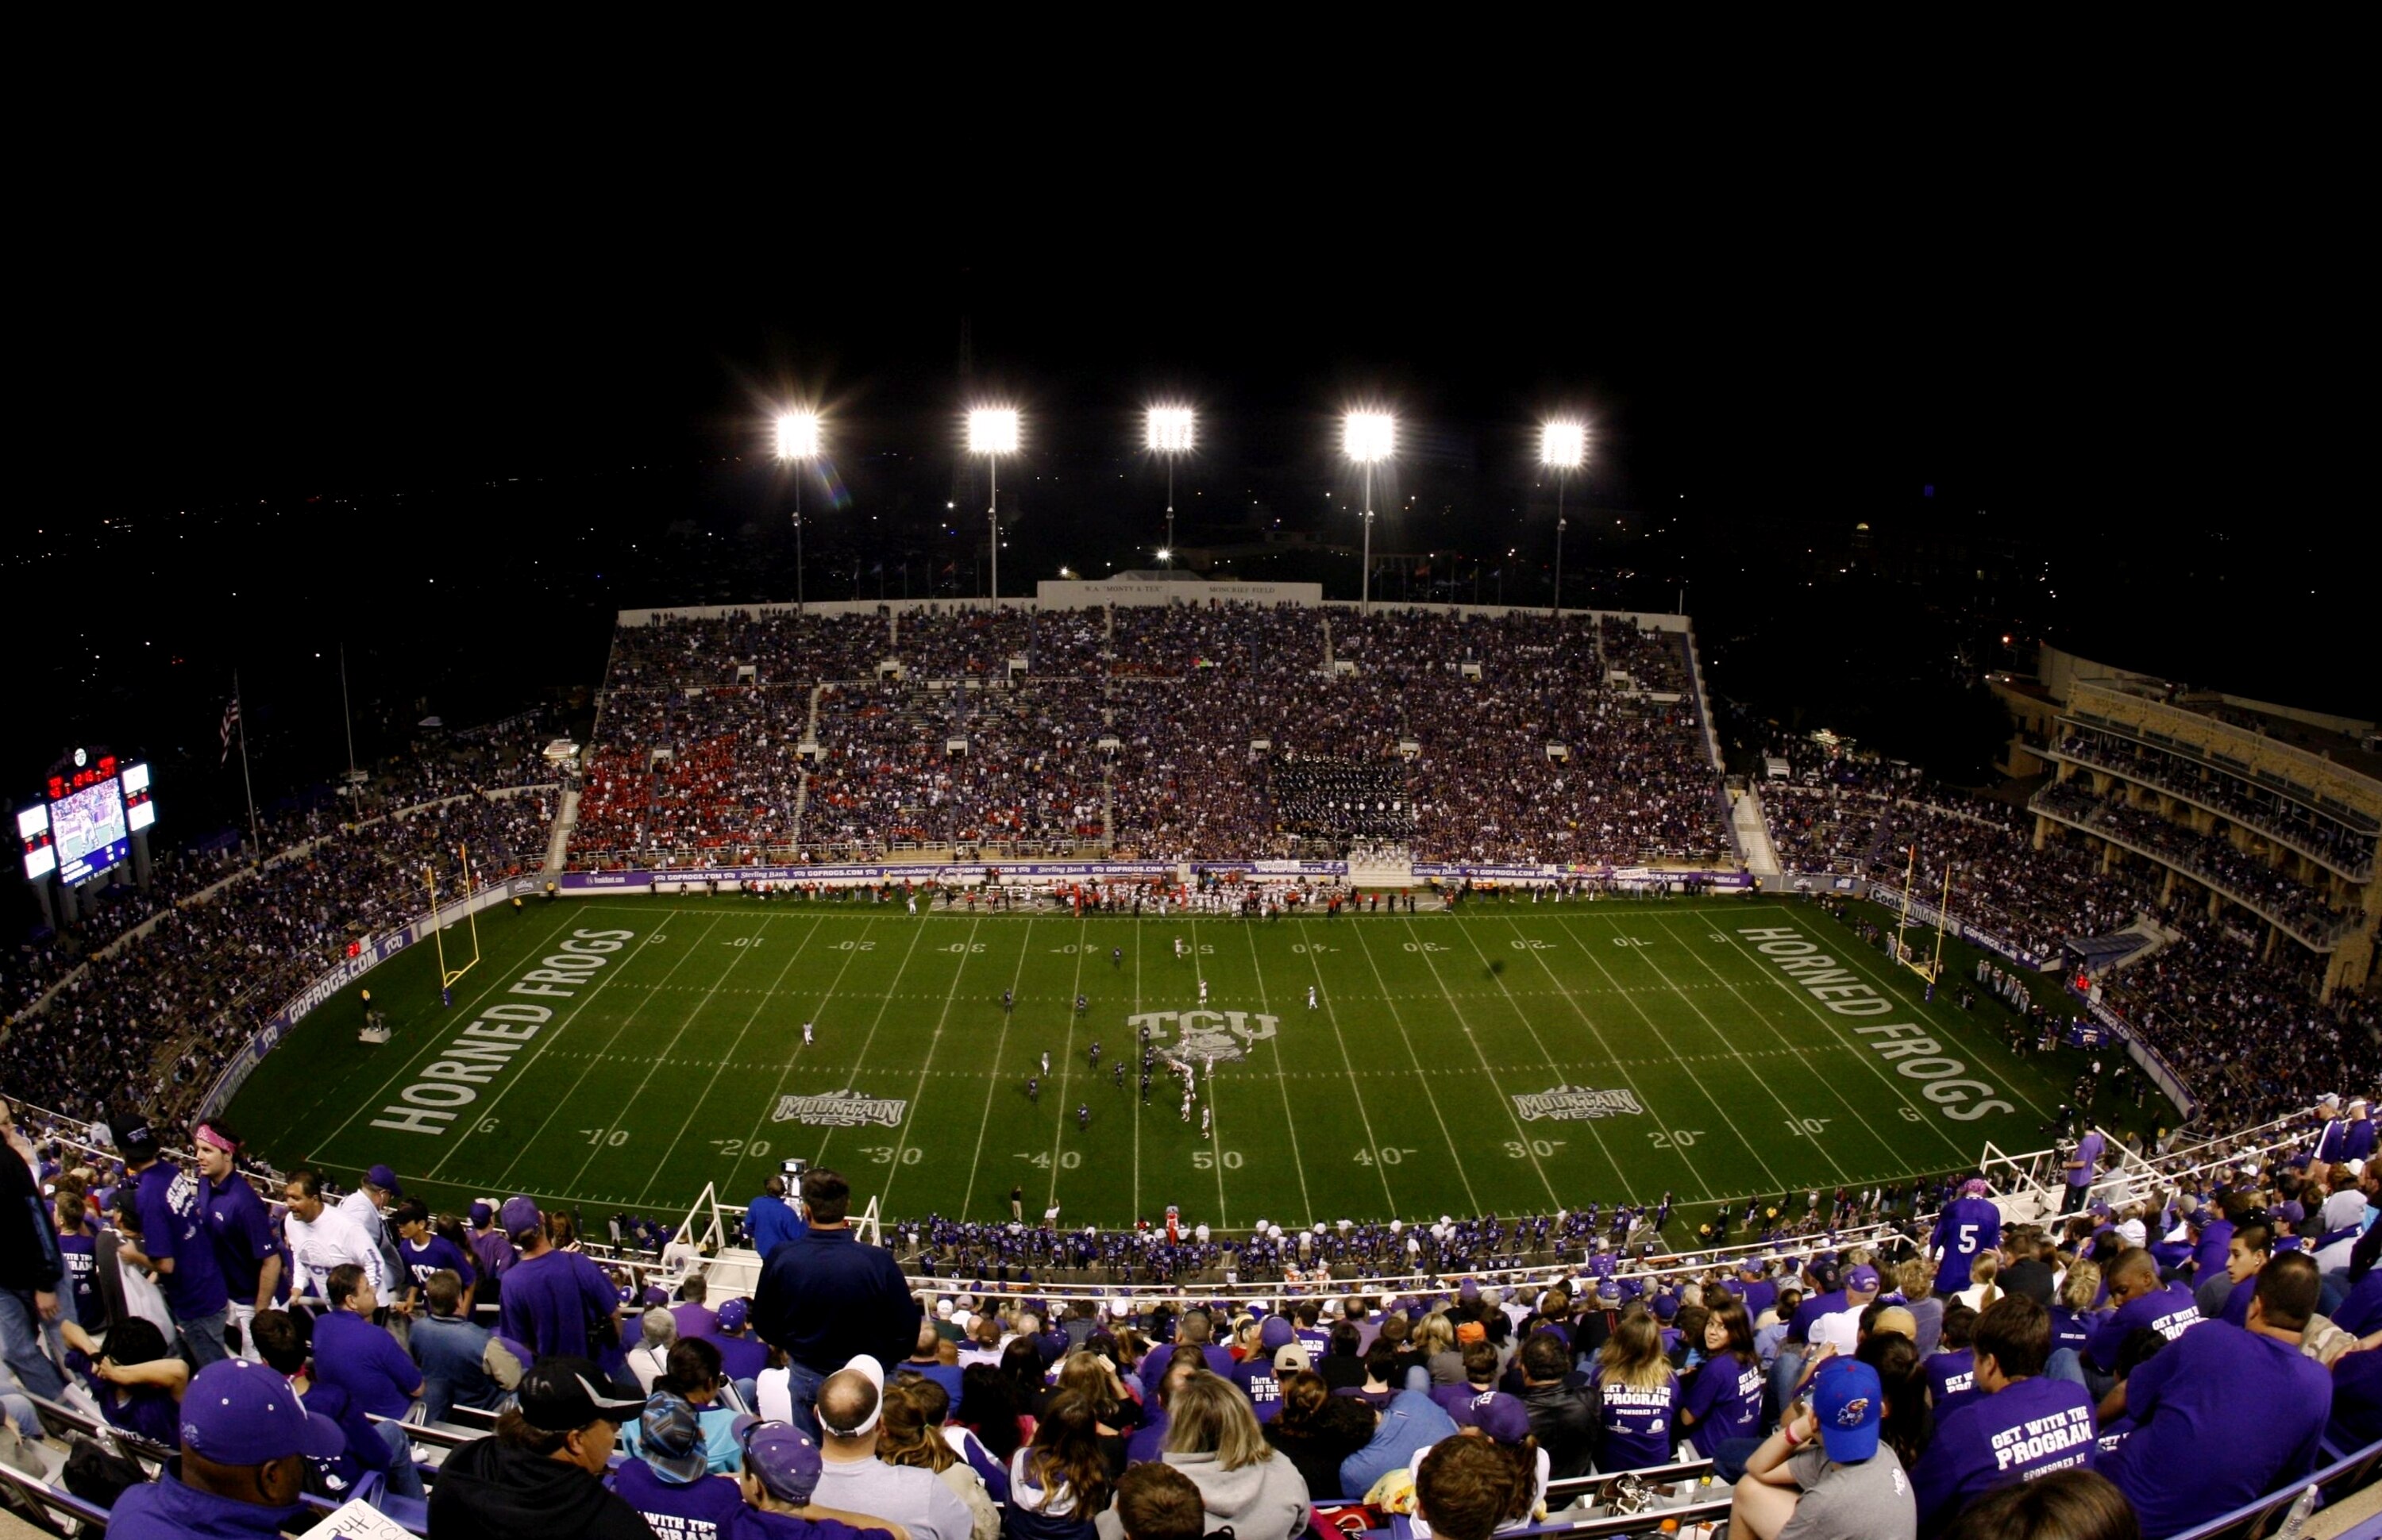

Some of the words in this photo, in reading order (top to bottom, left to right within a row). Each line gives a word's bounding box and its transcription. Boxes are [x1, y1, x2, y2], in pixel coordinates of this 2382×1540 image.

[347, 941, 360, 957] 21
[384, 934, 403, 955] TCU
[734, 937, 764, 949] 10
[841, 940, 877, 952] 20
[950, 942, 986, 953] 30
[1062, 944, 1100, 954] 40
[1181, 944, 1215, 955] 50
[1291, 943, 1327, 954] 40
[1403, 941, 1437, 953] 30
[1510, 939, 1544, 951] 20
[1612, 937, 1641, 948] 10
[288, 947, 379, 1024] GOFROGS.COM
[369, 1003, 553, 1135] HORNED
[507, 929, 634, 997] FROGS
[1127, 1010, 1280, 1041] TCU
[1736, 926, 1894, 1016] HORNED
[1853, 1022, 2016, 1121] FROGS
[262, 1025, 278, 1049] TCU
[773, 1095, 906, 1123] MOUNTAIN
[1512, 1088, 1644, 1118] MOUNTAIN
[800, 1115, 871, 1127] WEST
[1549, 1110, 1616, 1120] WEST
[1897, 1107, 1922, 1122] G
[478, 1118, 500, 1134] G
[1783, 1118, 1825, 1137] 10
[588, 1128, 630, 1146] 10
[1647, 1130, 1696, 1149] 20
[719, 1138, 771, 1158] 20
[870, 1146, 923, 1166] 30
[1353, 1146, 1403, 1166] 40
[1502, 1139, 1555, 1159] 30
[1031, 1151, 1082, 1169] 40
[1193, 1151, 1243, 1169] 50
[1957, 1224, 1979, 1254] 5
[2152, 1315, 2172, 1331] GET
[2172, 1307, 2195, 1322] WITH
[1251, 1384, 1264, 1394] AND
[1265, 1384, 1279, 1393] THE
[1945, 1374, 1964, 1386] GET
[1255, 1393, 1263, 1402] OF
[1603, 1393, 1671, 1407] PROGRAM
[1654, 1386, 1671, 1396] THE
[1991, 1426, 2022, 1450] GET
[2024, 1411, 2068, 1437] WITH
[2067, 1405, 2090, 1423] THE
[1995, 1420, 2094, 1471] PROGRAM
[2023, 1457, 2075, 1482] SPONSORED
[2076, 1452, 2086, 1465] BY
[643, 1511, 685, 1530] WITH
